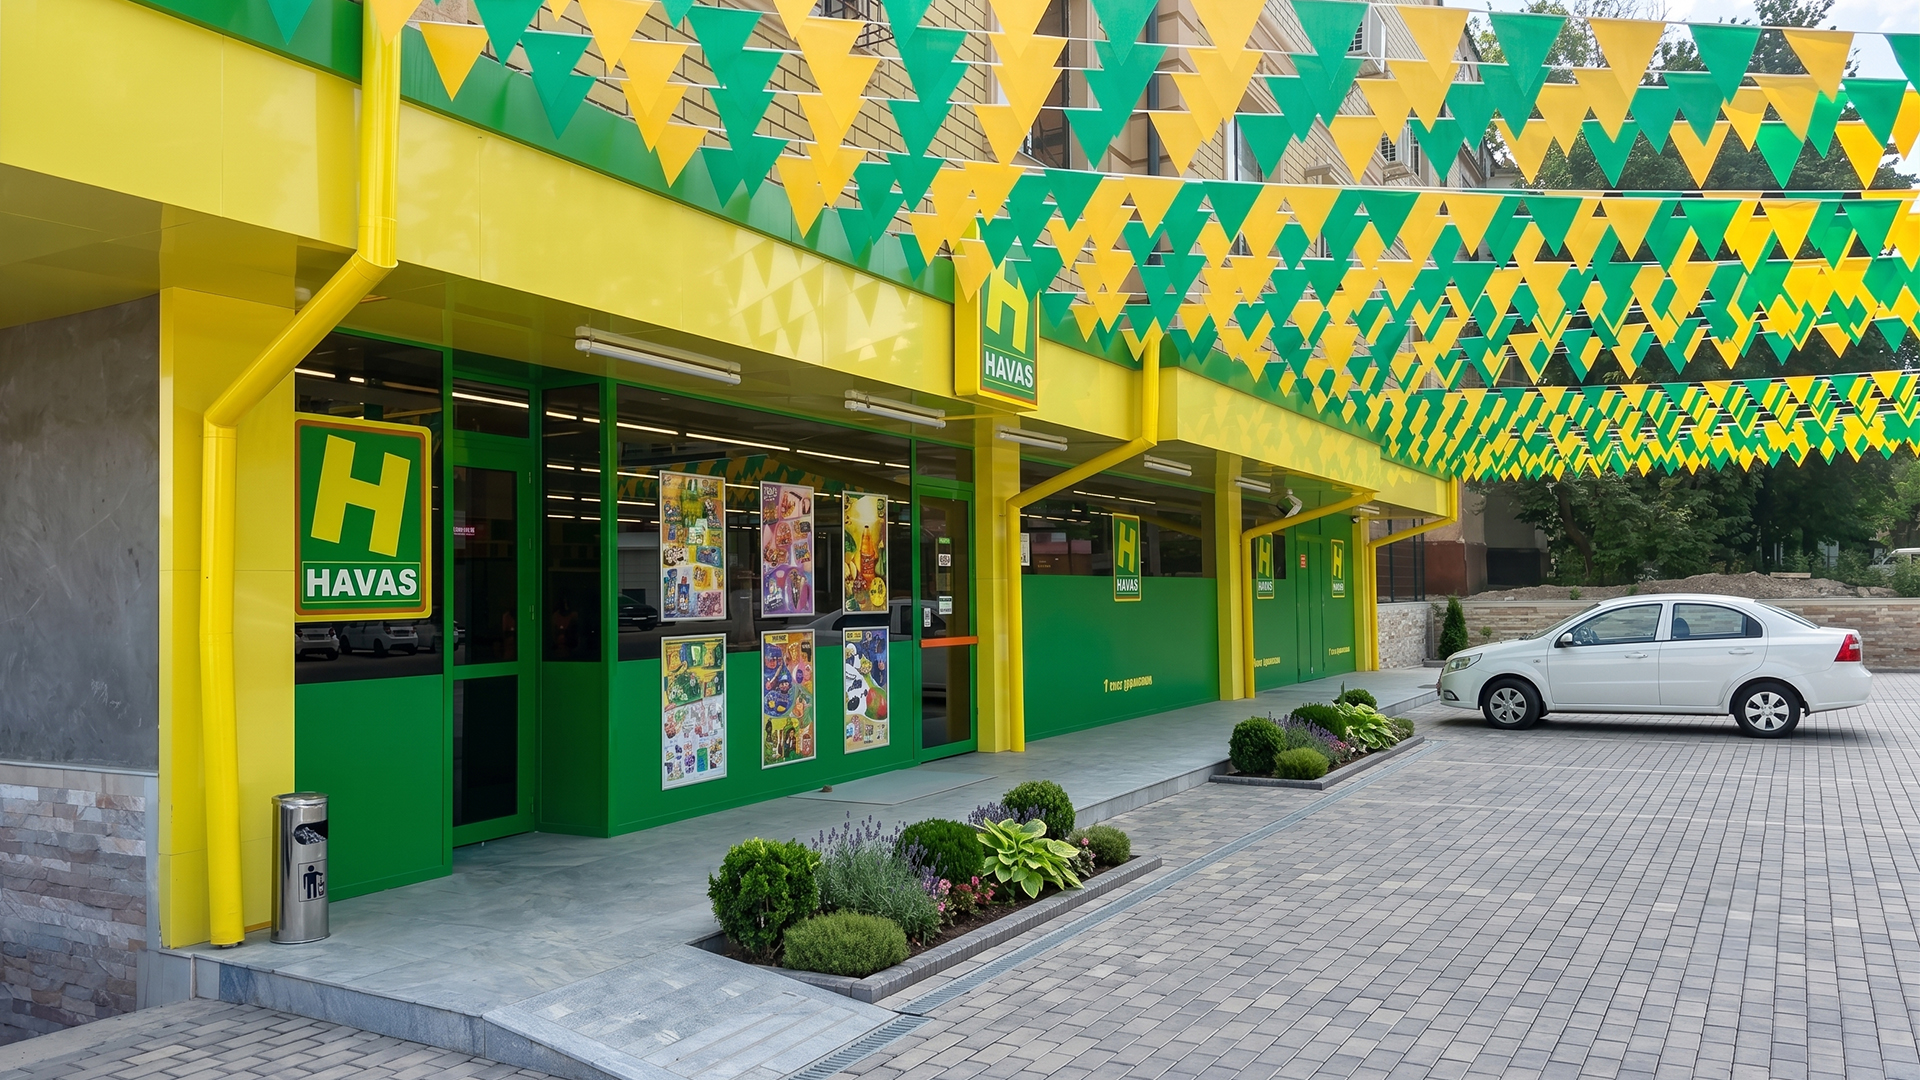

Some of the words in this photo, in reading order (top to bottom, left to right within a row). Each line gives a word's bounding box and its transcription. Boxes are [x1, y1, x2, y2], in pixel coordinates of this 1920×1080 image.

[986, 258, 1029, 355] H
[985, 351, 1034, 388] HAVAS
[311, 434, 411, 557] H
[1117, 521, 1136, 573] H
[1258, 536, 1271, 578] H
[1332, 544, 1343, 579] H
[306, 568, 418, 597] HAVAS
[1116, 578, 1138, 592] HAVAS
